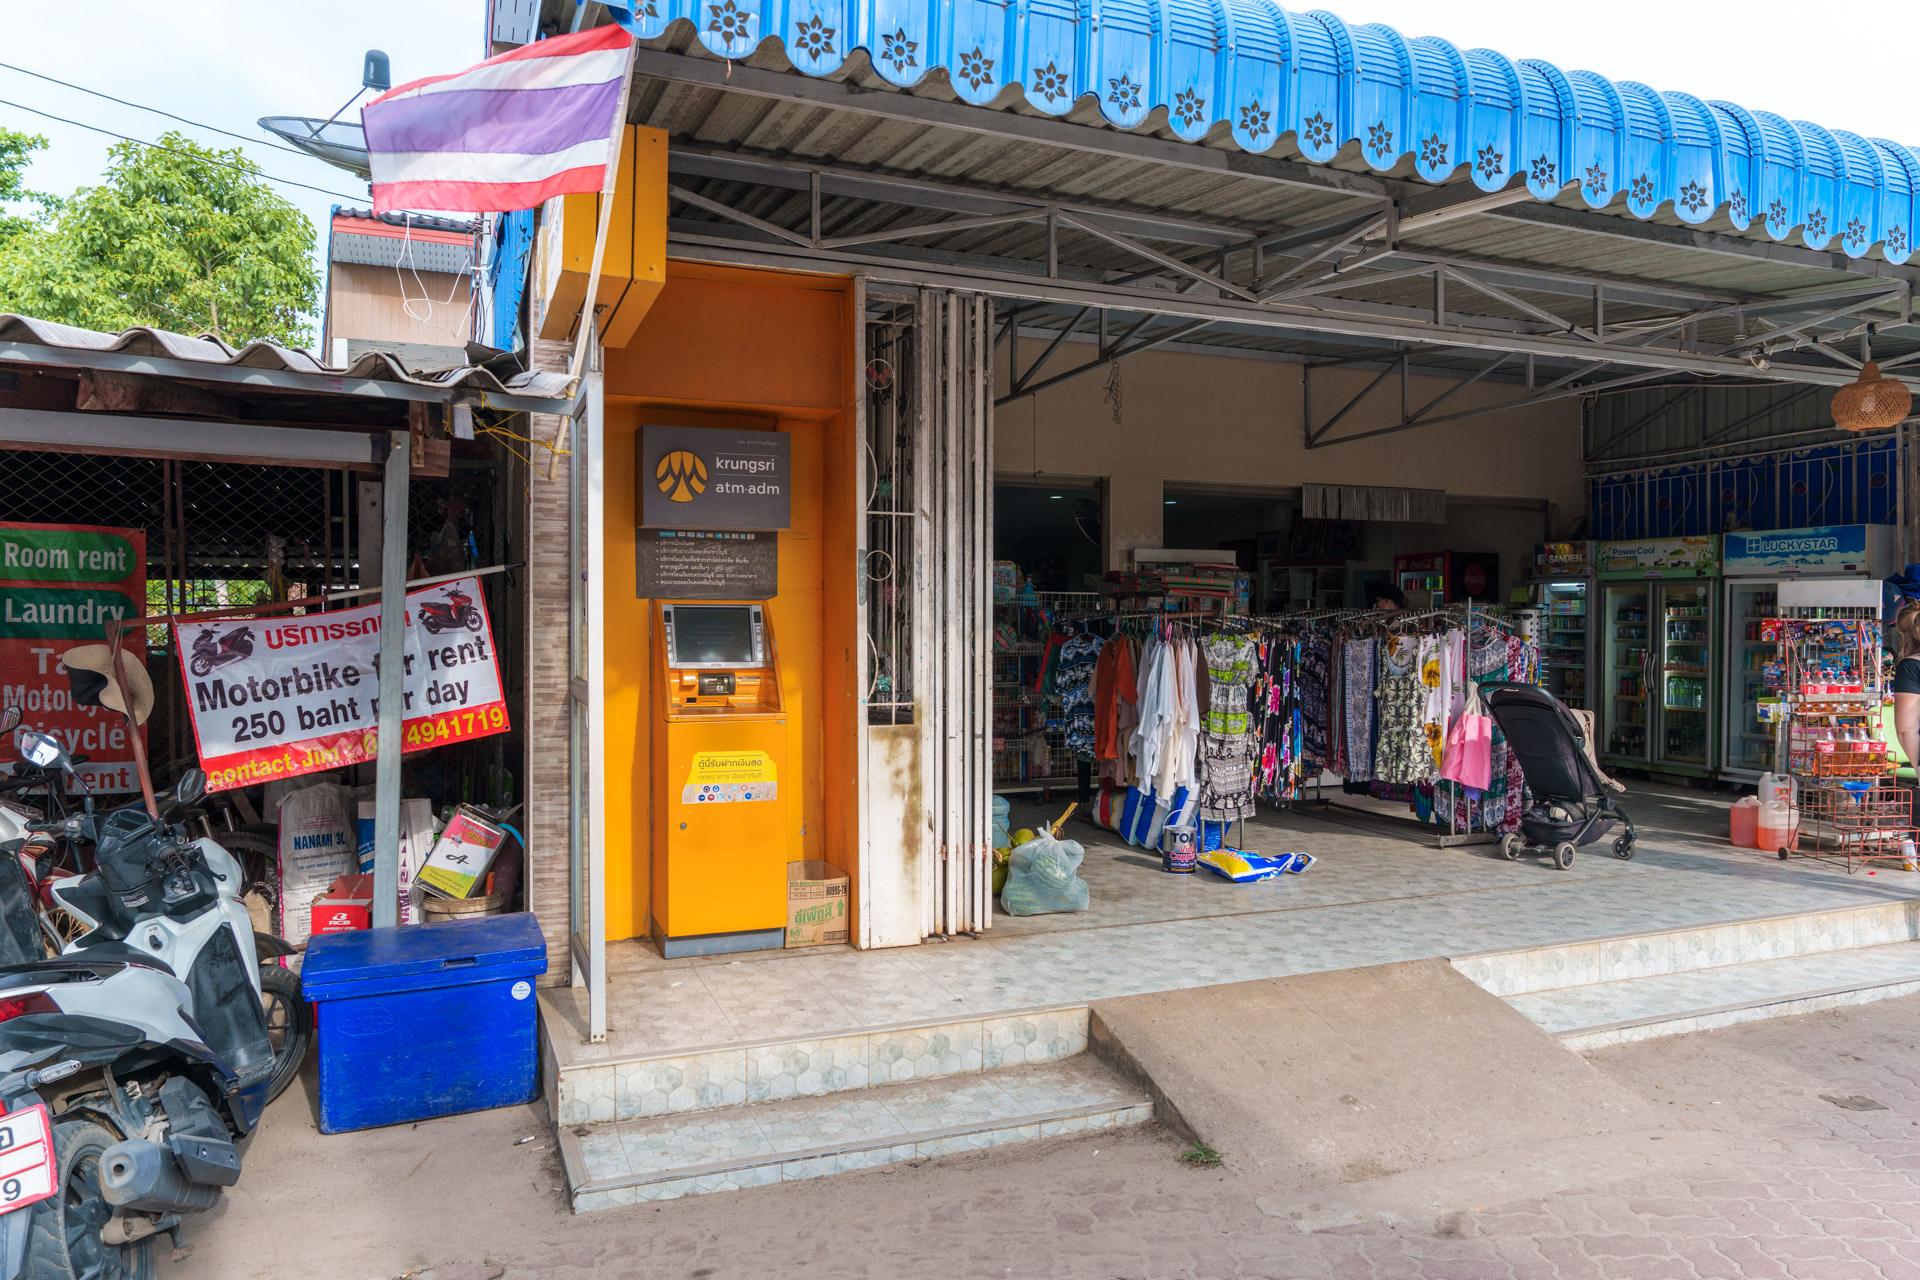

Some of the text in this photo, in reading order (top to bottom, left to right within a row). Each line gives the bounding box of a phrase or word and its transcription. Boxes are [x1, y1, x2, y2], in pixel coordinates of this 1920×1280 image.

[715, 456, 775, 473] krungsri
[1612, 546, 1656, 557] PowerCool
[1761, 536, 1838, 553] LUCKYSTAR
[4, 541, 127, 571] Room rent
[1548, 553, 1583, 563] SANDEN
[5, 598, 126, 625] Laundry
[195, 635, 488, 712] Motorbike fr rent
[232, 680, 469, 743] 250 baht pr day
[209, 752, 297, 785] contact
[302, 747, 339, 767] Jim
[66, 767, 130, 791] rent
[293, 833, 333, 850] NANAMI
[1170, 832, 1196, 843] TOA
